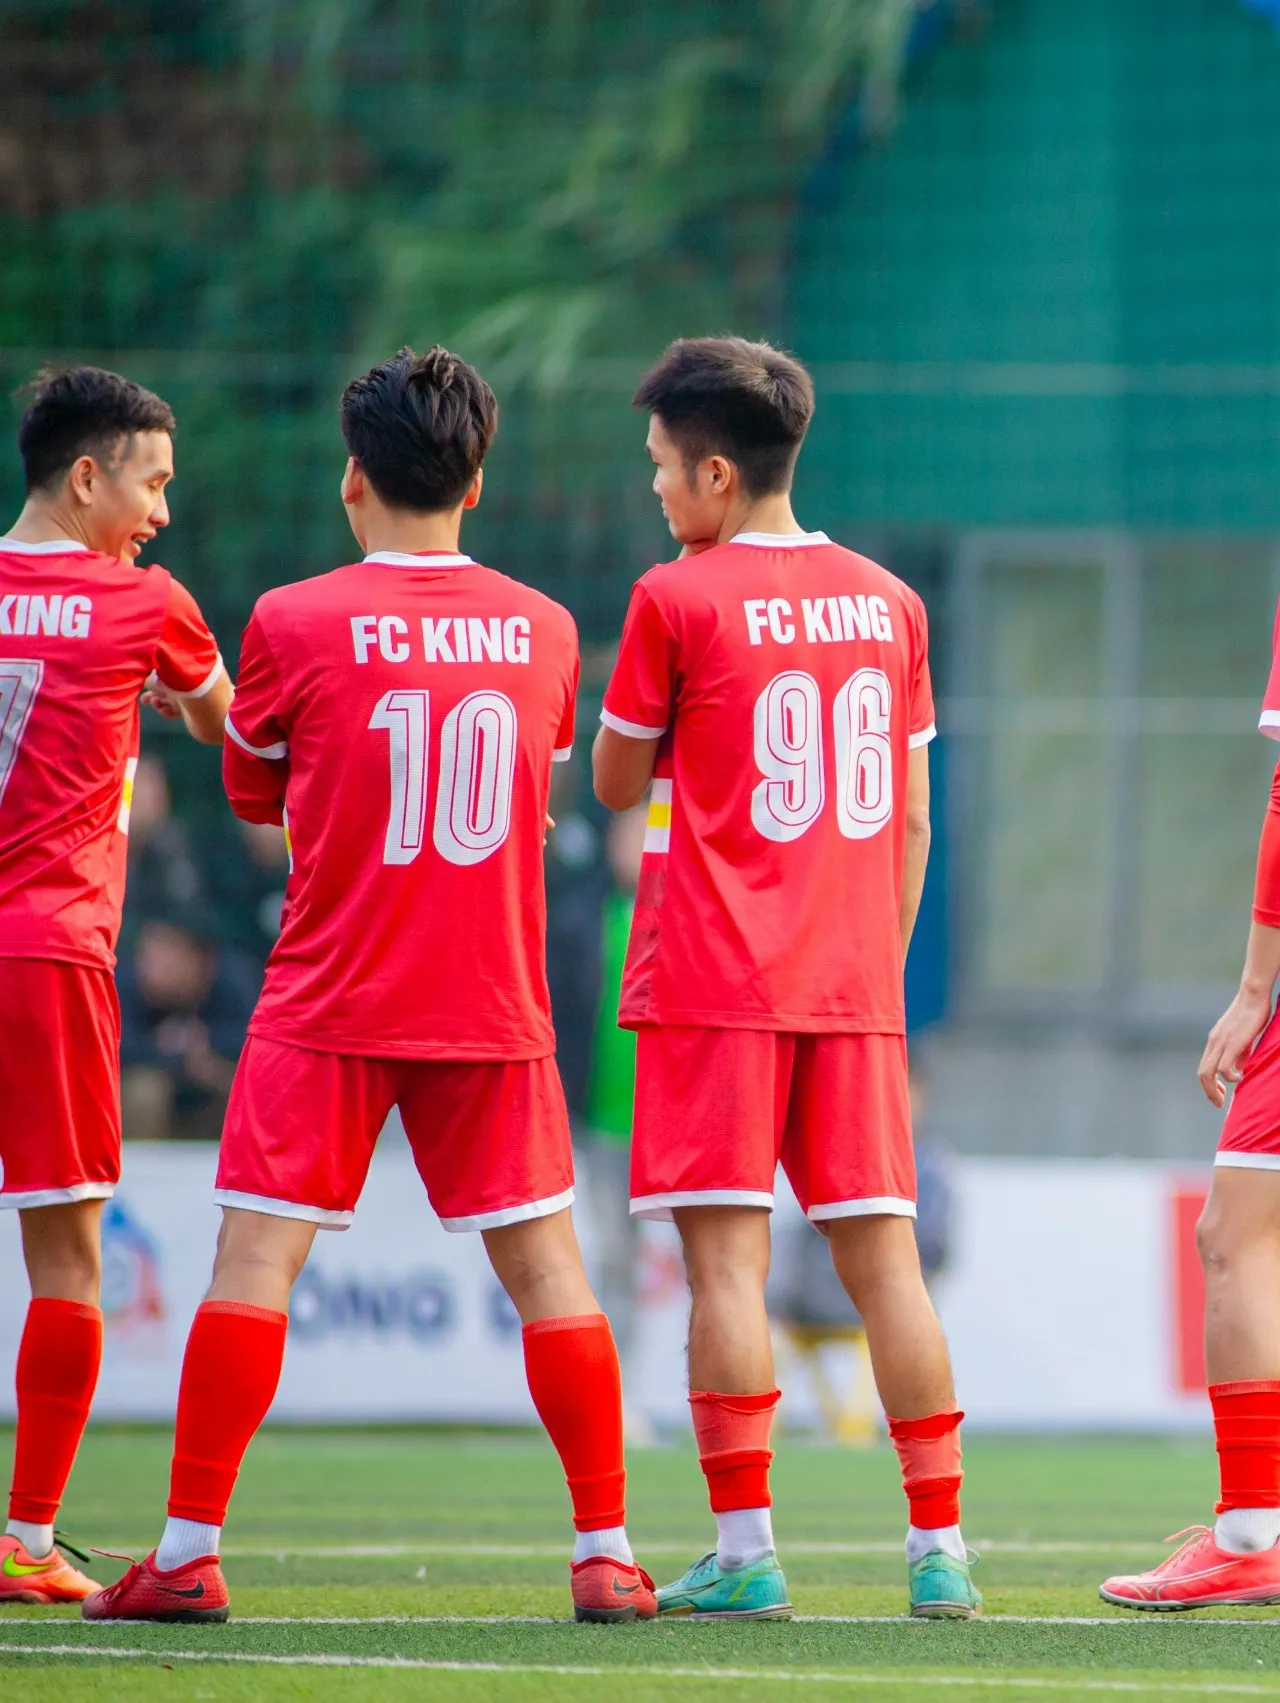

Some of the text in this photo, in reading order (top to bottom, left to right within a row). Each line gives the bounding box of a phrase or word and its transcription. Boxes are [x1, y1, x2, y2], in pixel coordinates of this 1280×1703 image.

[350, 616, 530, 664] FC KING
[743, 594, 893, 645] FC KING
[367, 689, 517, 866] 10
[751, 667, 893, 843] 96
